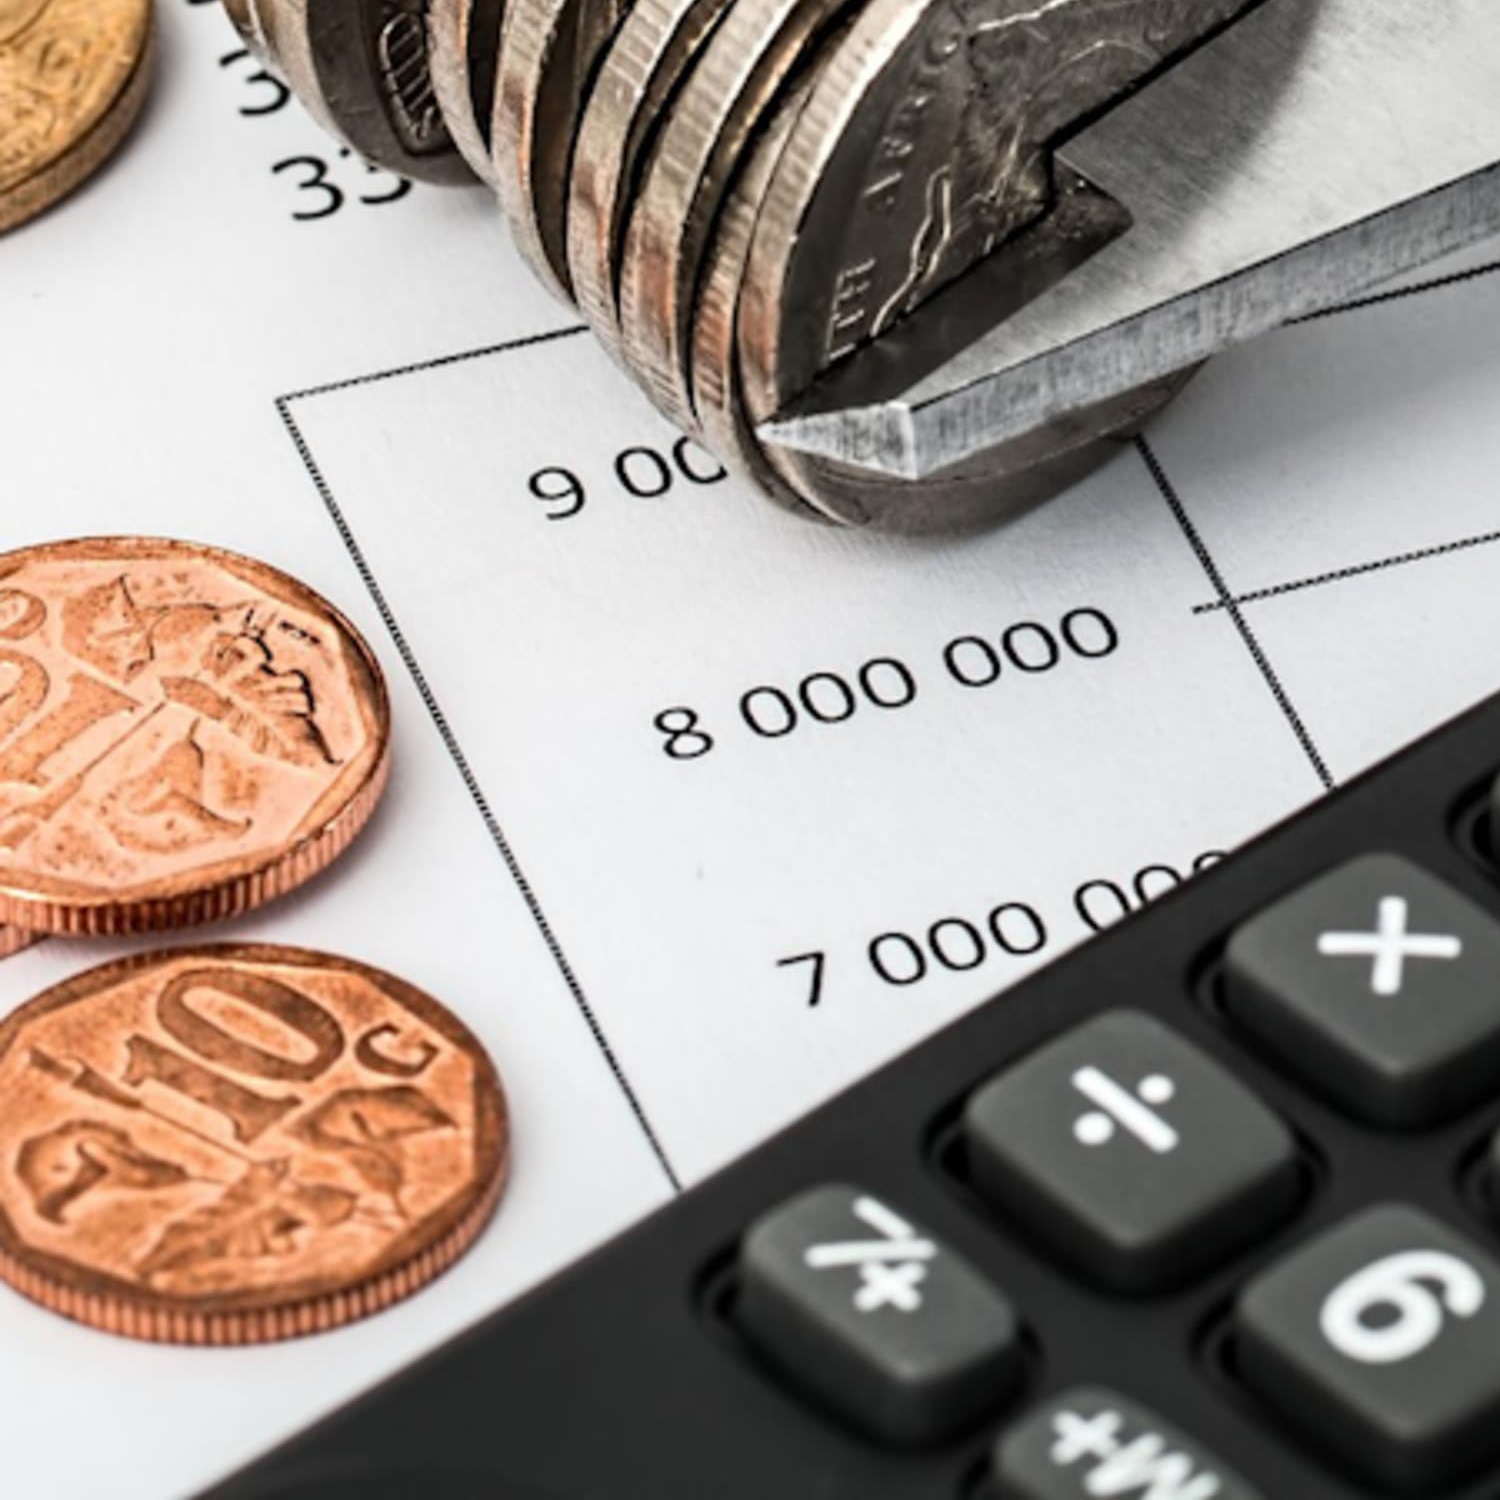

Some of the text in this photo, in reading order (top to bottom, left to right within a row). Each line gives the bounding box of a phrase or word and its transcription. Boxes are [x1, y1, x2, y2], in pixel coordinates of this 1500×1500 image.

[527, 466, 586, 521] 9
[653, 605, 1121, 760] 8 000 000
[775, 950, 827, 1008] 7
[867, 901, 1048, 986] 000
